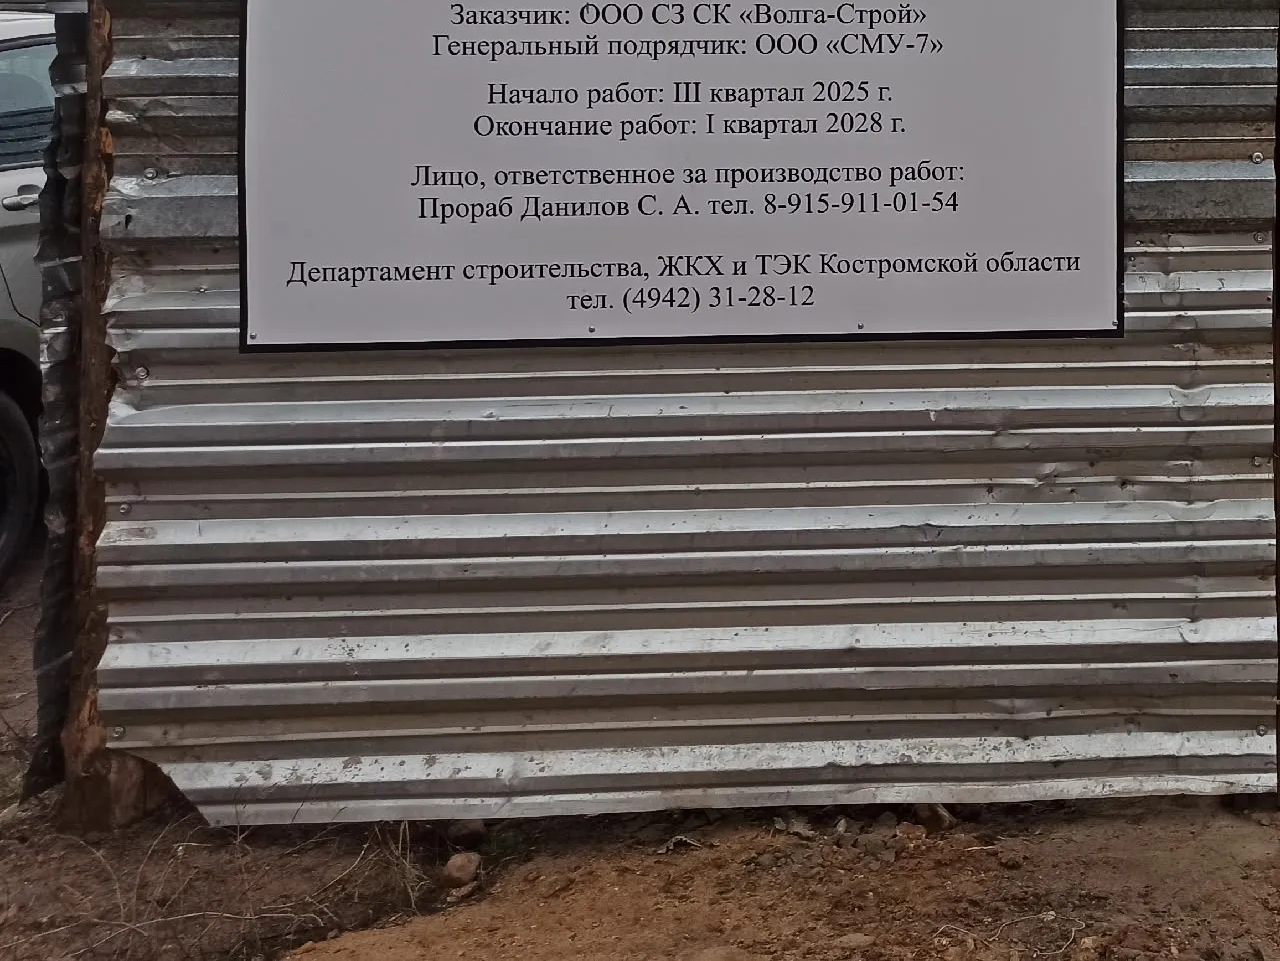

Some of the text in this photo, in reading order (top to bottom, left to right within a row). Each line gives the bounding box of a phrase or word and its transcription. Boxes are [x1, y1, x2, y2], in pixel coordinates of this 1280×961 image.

[450, 2, 927, 30] Заказчик: ООО СЗ СК «Волга-Строй»
[431, 33, 944, 62] Генеральный подрядчик: ООО «СМУ-7»
[487, 80, 892, 110] Начало работ: III квартал 2025 г.
[473, 111, 906, 142] Окончание работ: I квартал 2028 г.
[410, 159, 964, 190] Лицо, ответственное за производство работ:
[417, 191, 959, 225] Прораб Данилов С. А. тел. 8-915-911-01-54
[285, 250, 1081, 288] Департамент строительства, ЖКХ и ТЭК Костромской области
[565, 285, 815, 315] тел. (4942) 31-28-12
